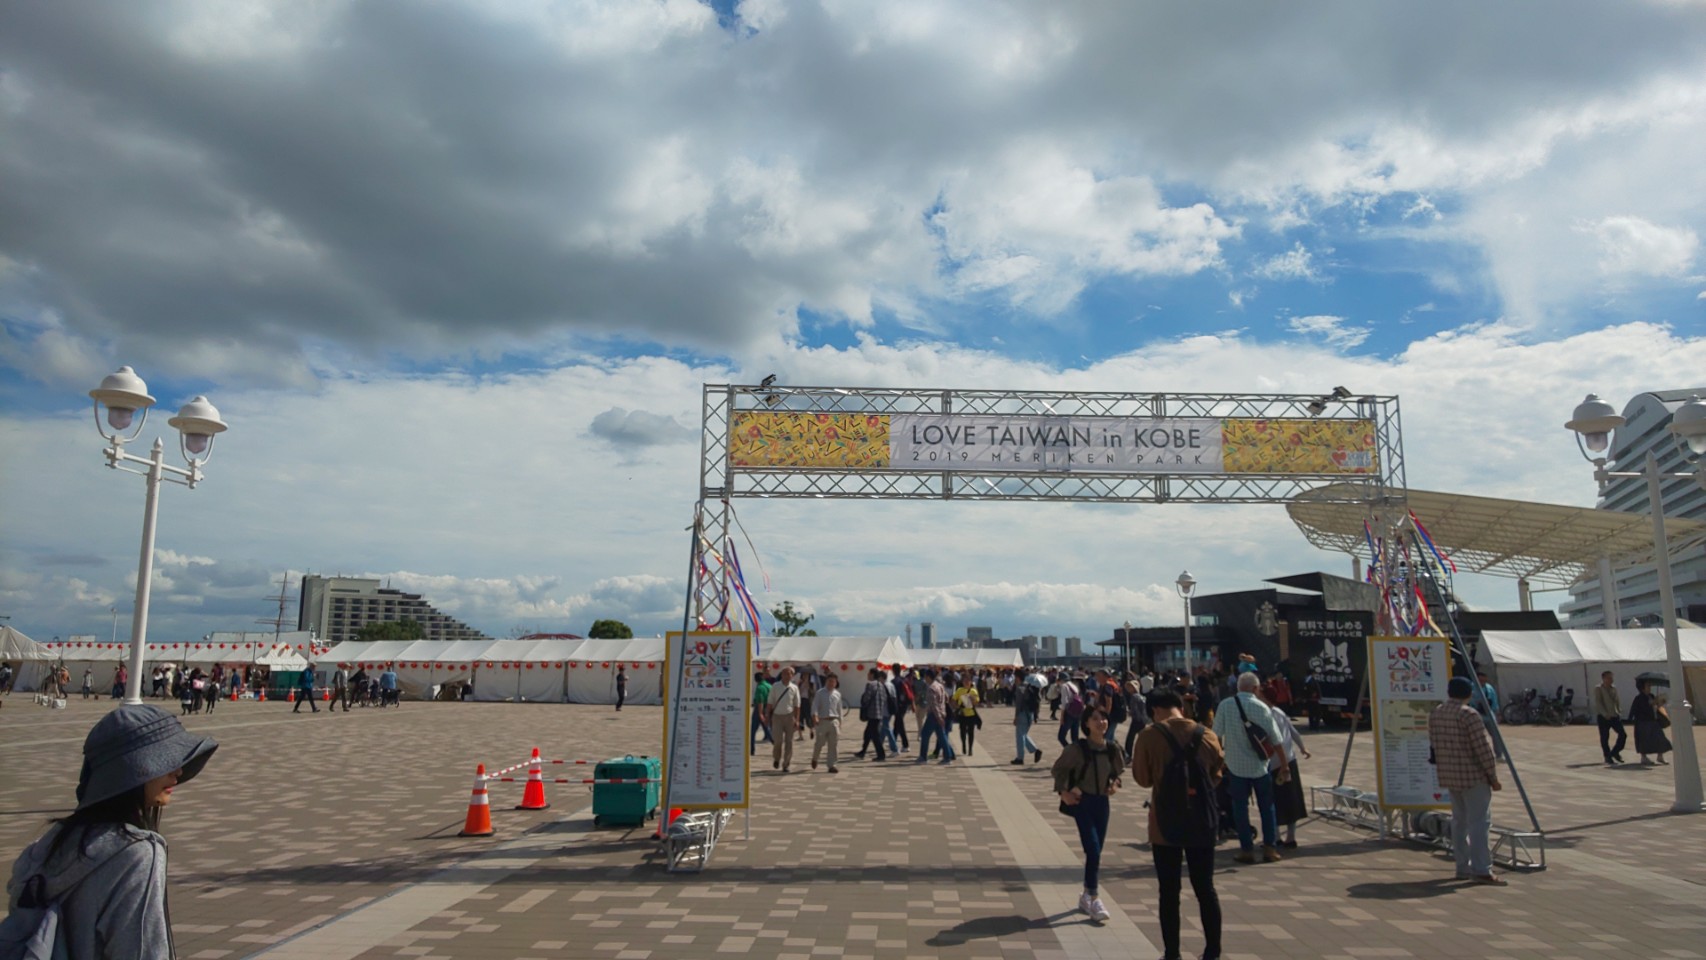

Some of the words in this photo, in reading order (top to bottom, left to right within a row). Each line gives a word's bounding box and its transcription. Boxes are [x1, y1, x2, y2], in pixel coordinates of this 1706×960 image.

[912, 425, 976, 446] LOVE
[986, 426, 1091, 447] TAIWAN
[1103, 428, 1122, 448] in
[1134, 428, 1201, 449] KOBE
[913, 451, 968, 461] 2019
[991, 453, 1114, 464] MERIKEN
[1137, 455, 1202, 465] PARK
